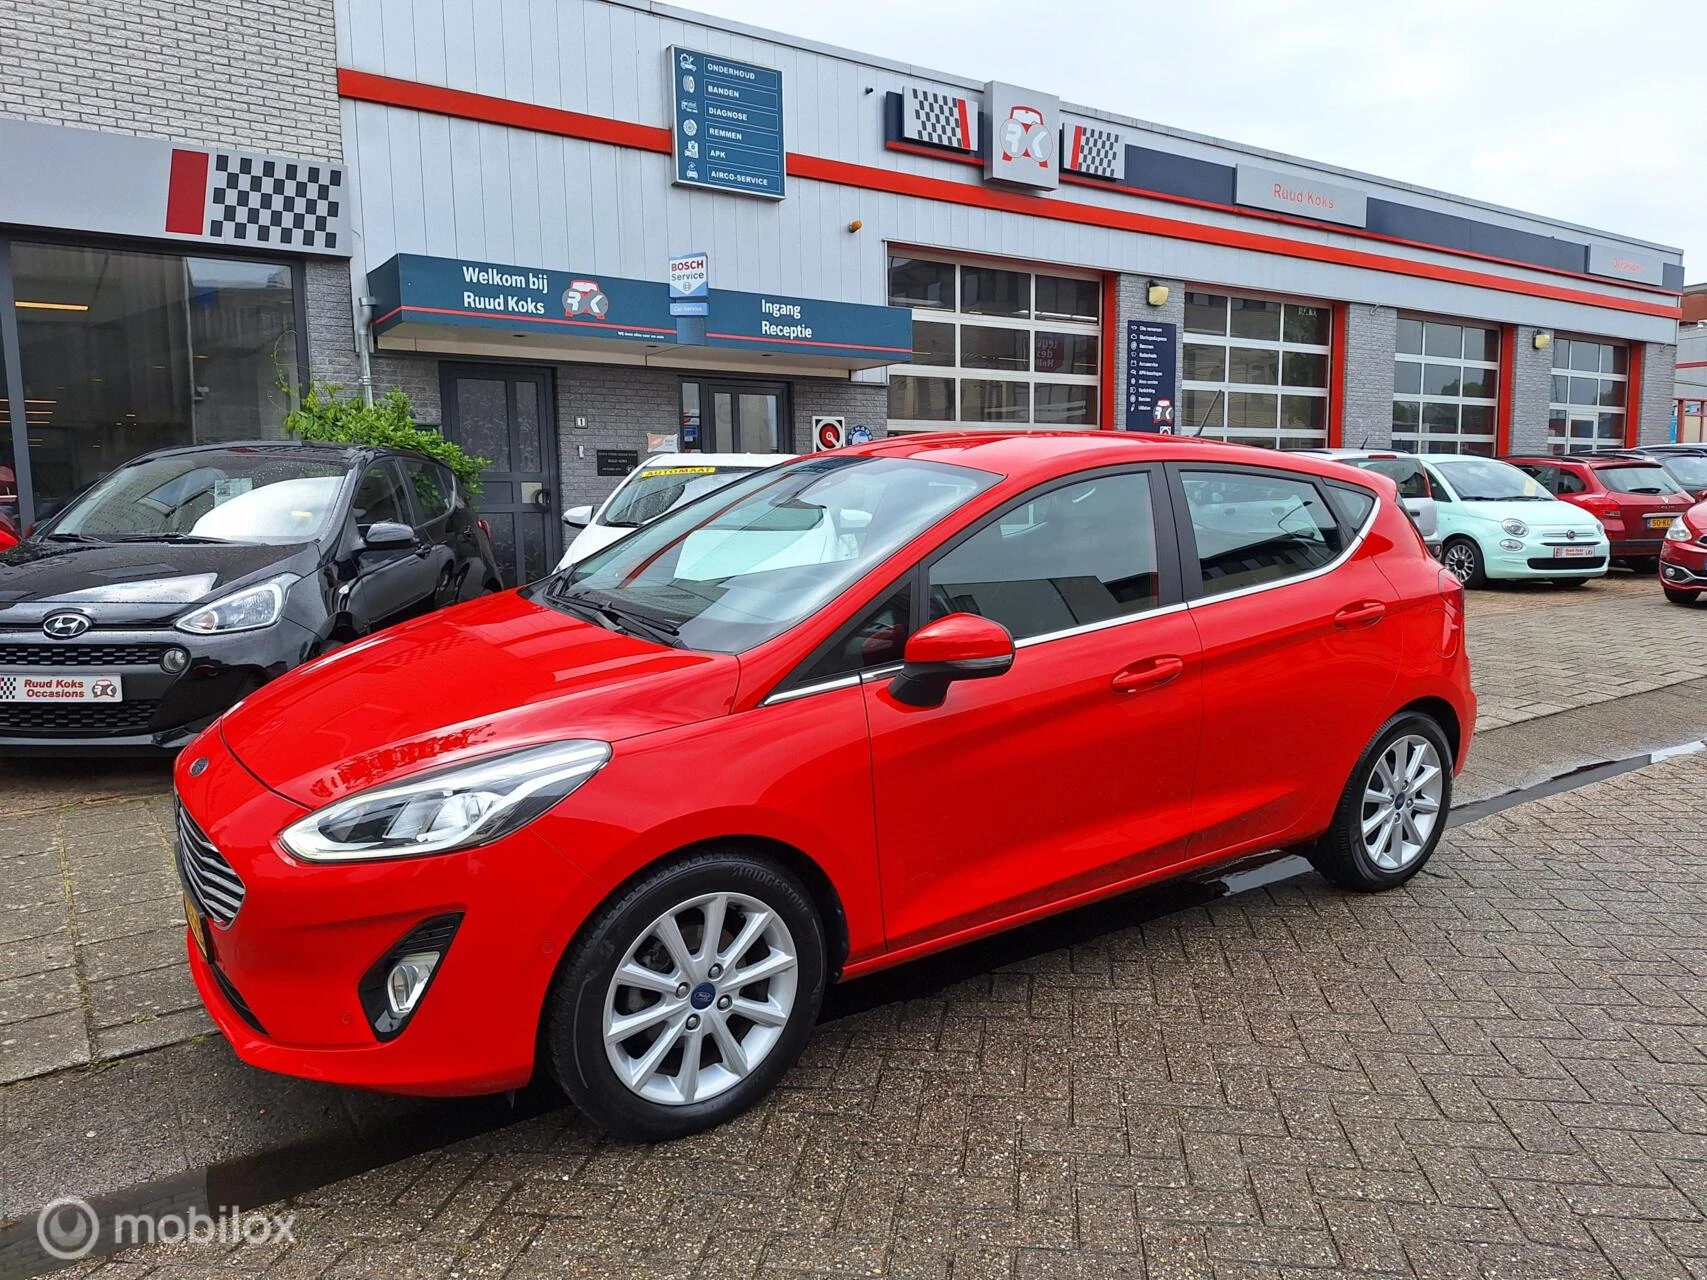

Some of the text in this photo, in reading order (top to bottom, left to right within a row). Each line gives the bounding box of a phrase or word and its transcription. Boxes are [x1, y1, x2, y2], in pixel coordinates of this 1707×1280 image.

[707, 63, 756, 80] ONDERHOUD
[707, 84, 740, 98] BANDEN
[708, 106, 748, 121] DIAGNOSE
[709, 127, 742, 140] REMMEN
[710, 149, 726, 159] APK
[710, 170, 768, 186] AIRCO-SERVICE
[1273, 183, 1304, 203] Ruud
[671, 259, 704, 271] BOSCH
[462, 266, 549, 294] Welkom bij
[671, 271, 705, 281] Service
[463, 291, 545, 314] Ruud Koks
[761, 299, 801, 319] Ingang
[761, 320, 812, 340] Receptie
[646, 467, 714, 476] AUTOMAAT
[24, 679, 84, 689] Ruud Koks
[26, 689, 85, 698] Occasions
[730, 865, 809, 913] BRIDGESTONE
